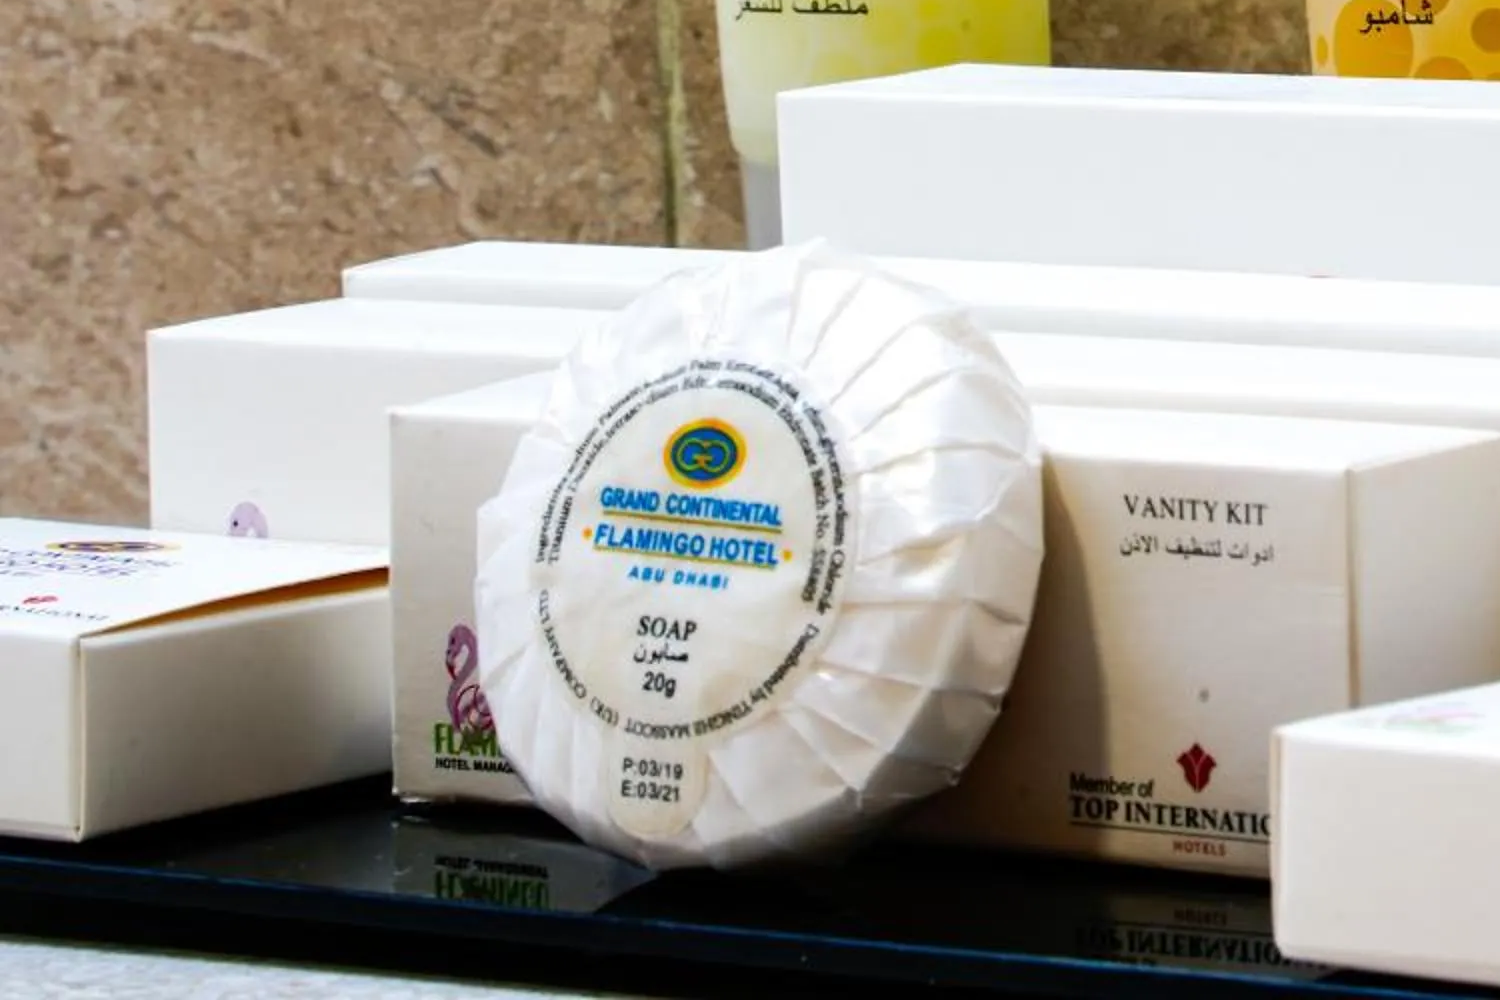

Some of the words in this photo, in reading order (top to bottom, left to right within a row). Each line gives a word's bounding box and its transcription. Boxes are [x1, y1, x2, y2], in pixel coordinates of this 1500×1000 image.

[600, 486, 660, 512] GRAND
[666, 493, 782, 526] CONTINENTAL
[1123, 494, 1219, 522] VANITY
[1226, 501, 1269, 526] KIT
[594, 523, 705, 556] FLAMINGO
[709, 535, 779, 565] HOTEL
[628, 565, 665, 583] ABU
[673, 569, 729, 590] DHABI
[637, 615, 697, 641] SOAP
[642, 671, 677, 698] 20g
[434, 722, 501, 757] FLAM
[435, 757, 470, 771] HOTEL
[473, 760, 515, 774] MANAG
[622, 757, 683, 780] P:03/19
[621, 780, 680, 803] E:03/21
[1069, 772, 1135, 796] Member
[1138, 779, 1153, 798] of
[1070, 796, 1120, 821] TOP
[1126, 800, 1271, 838] INTERNATIO
[1173, 840, 1227, 858] HOTELS
